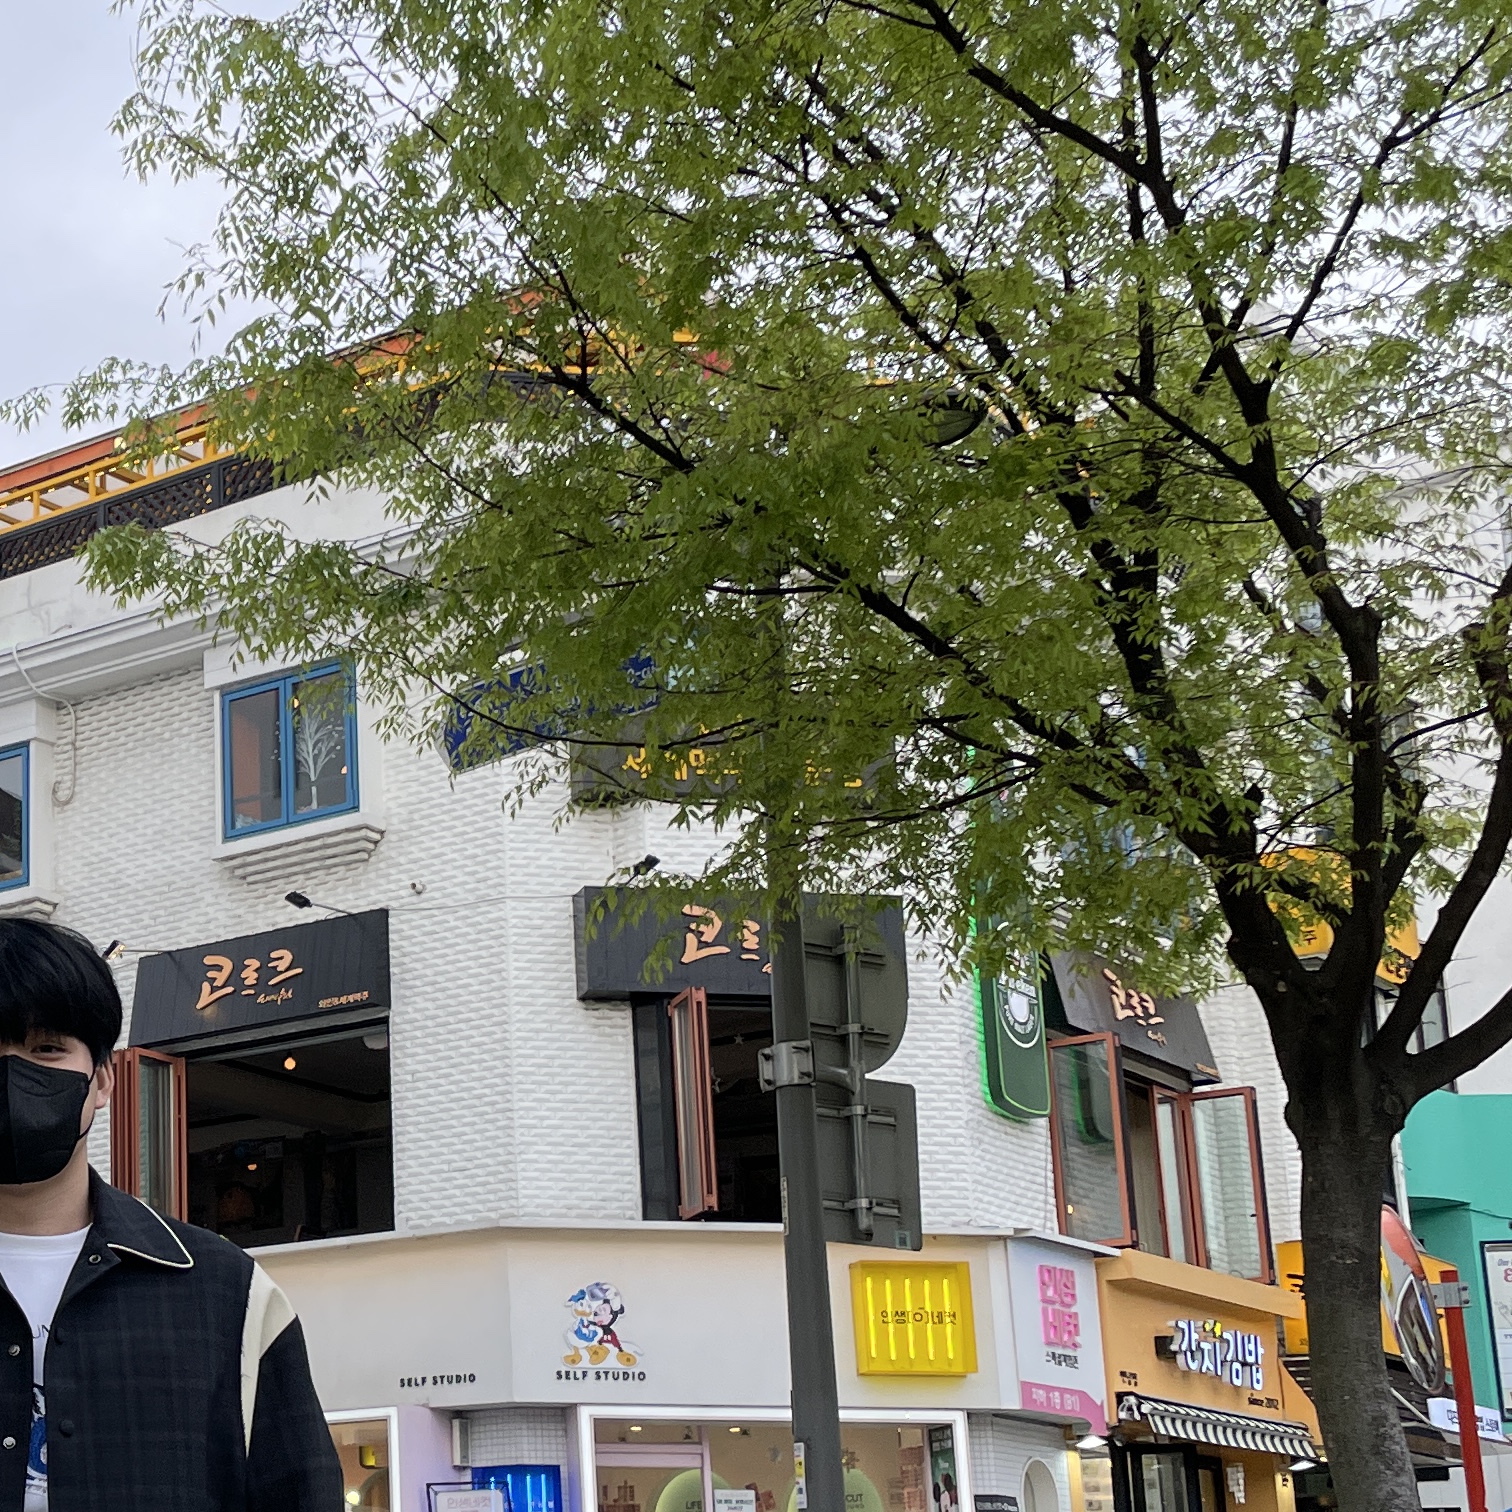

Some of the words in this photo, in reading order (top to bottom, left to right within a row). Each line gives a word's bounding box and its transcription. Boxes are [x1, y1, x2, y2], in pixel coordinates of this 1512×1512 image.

[679, 904, 761, 964] 코르
[196, 949, 303, 1010] 코르크
[1103, 967, 1165, 1027] 코르크
[399, 1378, 427, 1388] SELF
[432, 1373, 476, 1386] STUDIO
[556, 1370, 589, 1381] SELF
[594, 1370, 647, 1381] STUDIO
[1175, 1319, 1265, 1391] 간지김밥
